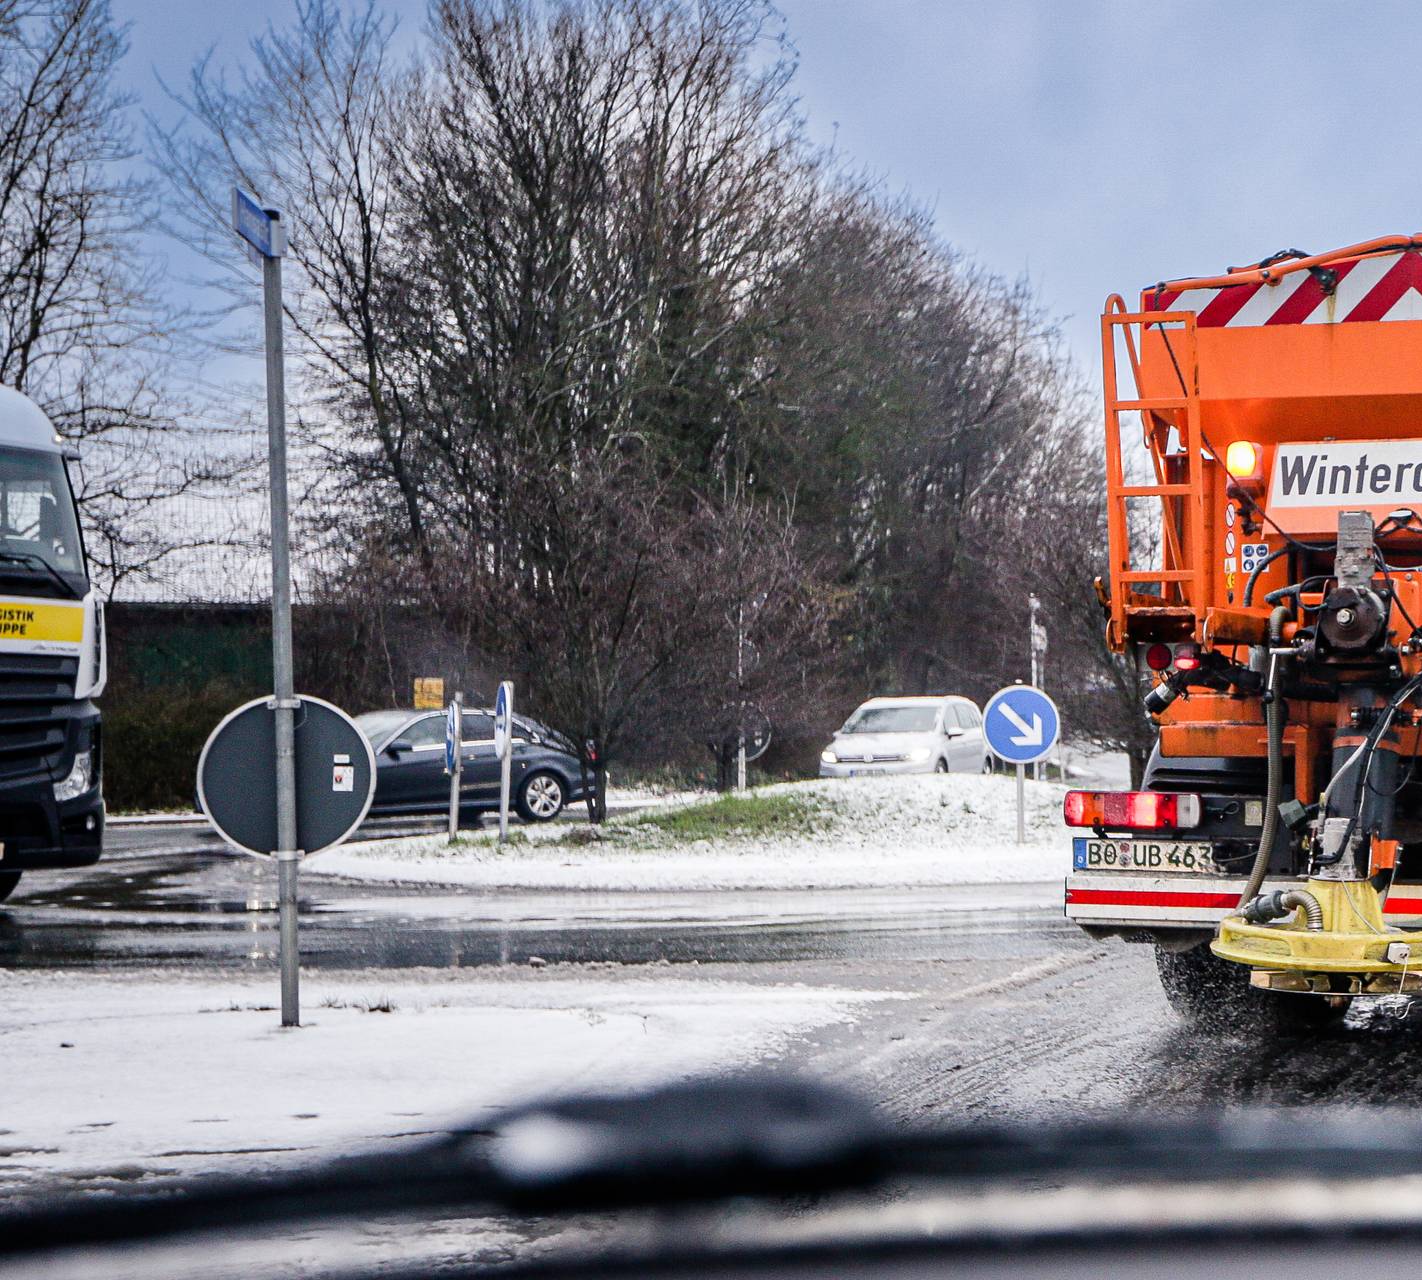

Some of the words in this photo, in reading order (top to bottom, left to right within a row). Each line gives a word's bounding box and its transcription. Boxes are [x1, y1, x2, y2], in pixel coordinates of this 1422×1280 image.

[1088, 843, 1117, 865] BO
[1133, 844, 1161, 867] UB
[1168, 845, 1211, 868] 463
